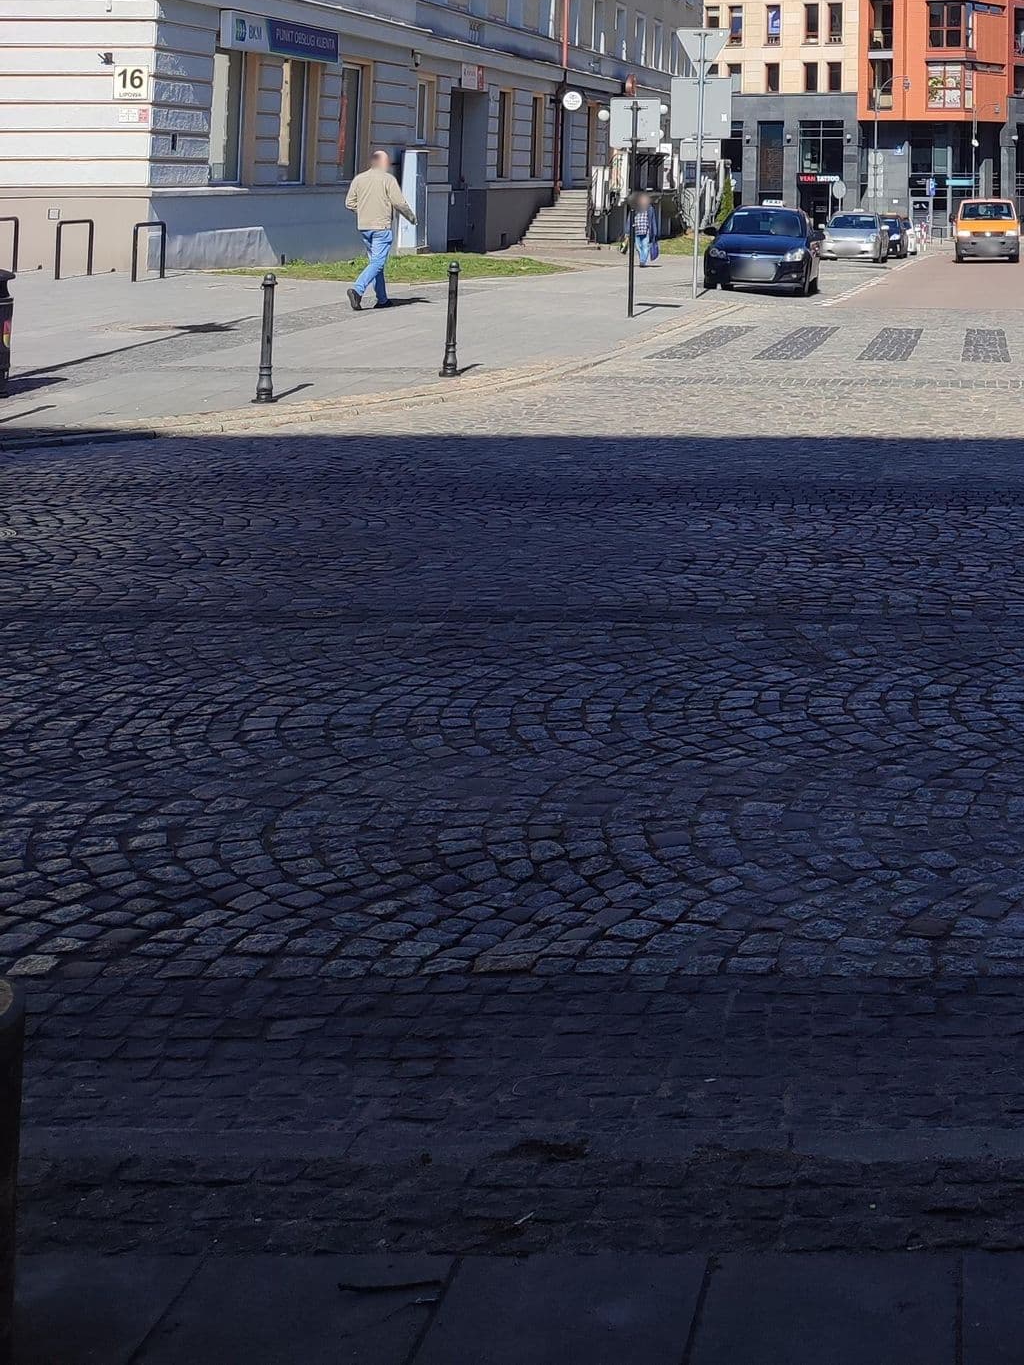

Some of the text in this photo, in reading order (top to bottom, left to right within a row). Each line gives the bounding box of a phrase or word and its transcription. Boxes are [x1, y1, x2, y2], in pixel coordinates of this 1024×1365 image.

[276, 28, 294, 43] PUNKT
[316, 37, 336, 51] KLIENTA
[118, 68, 143, 89] 16
